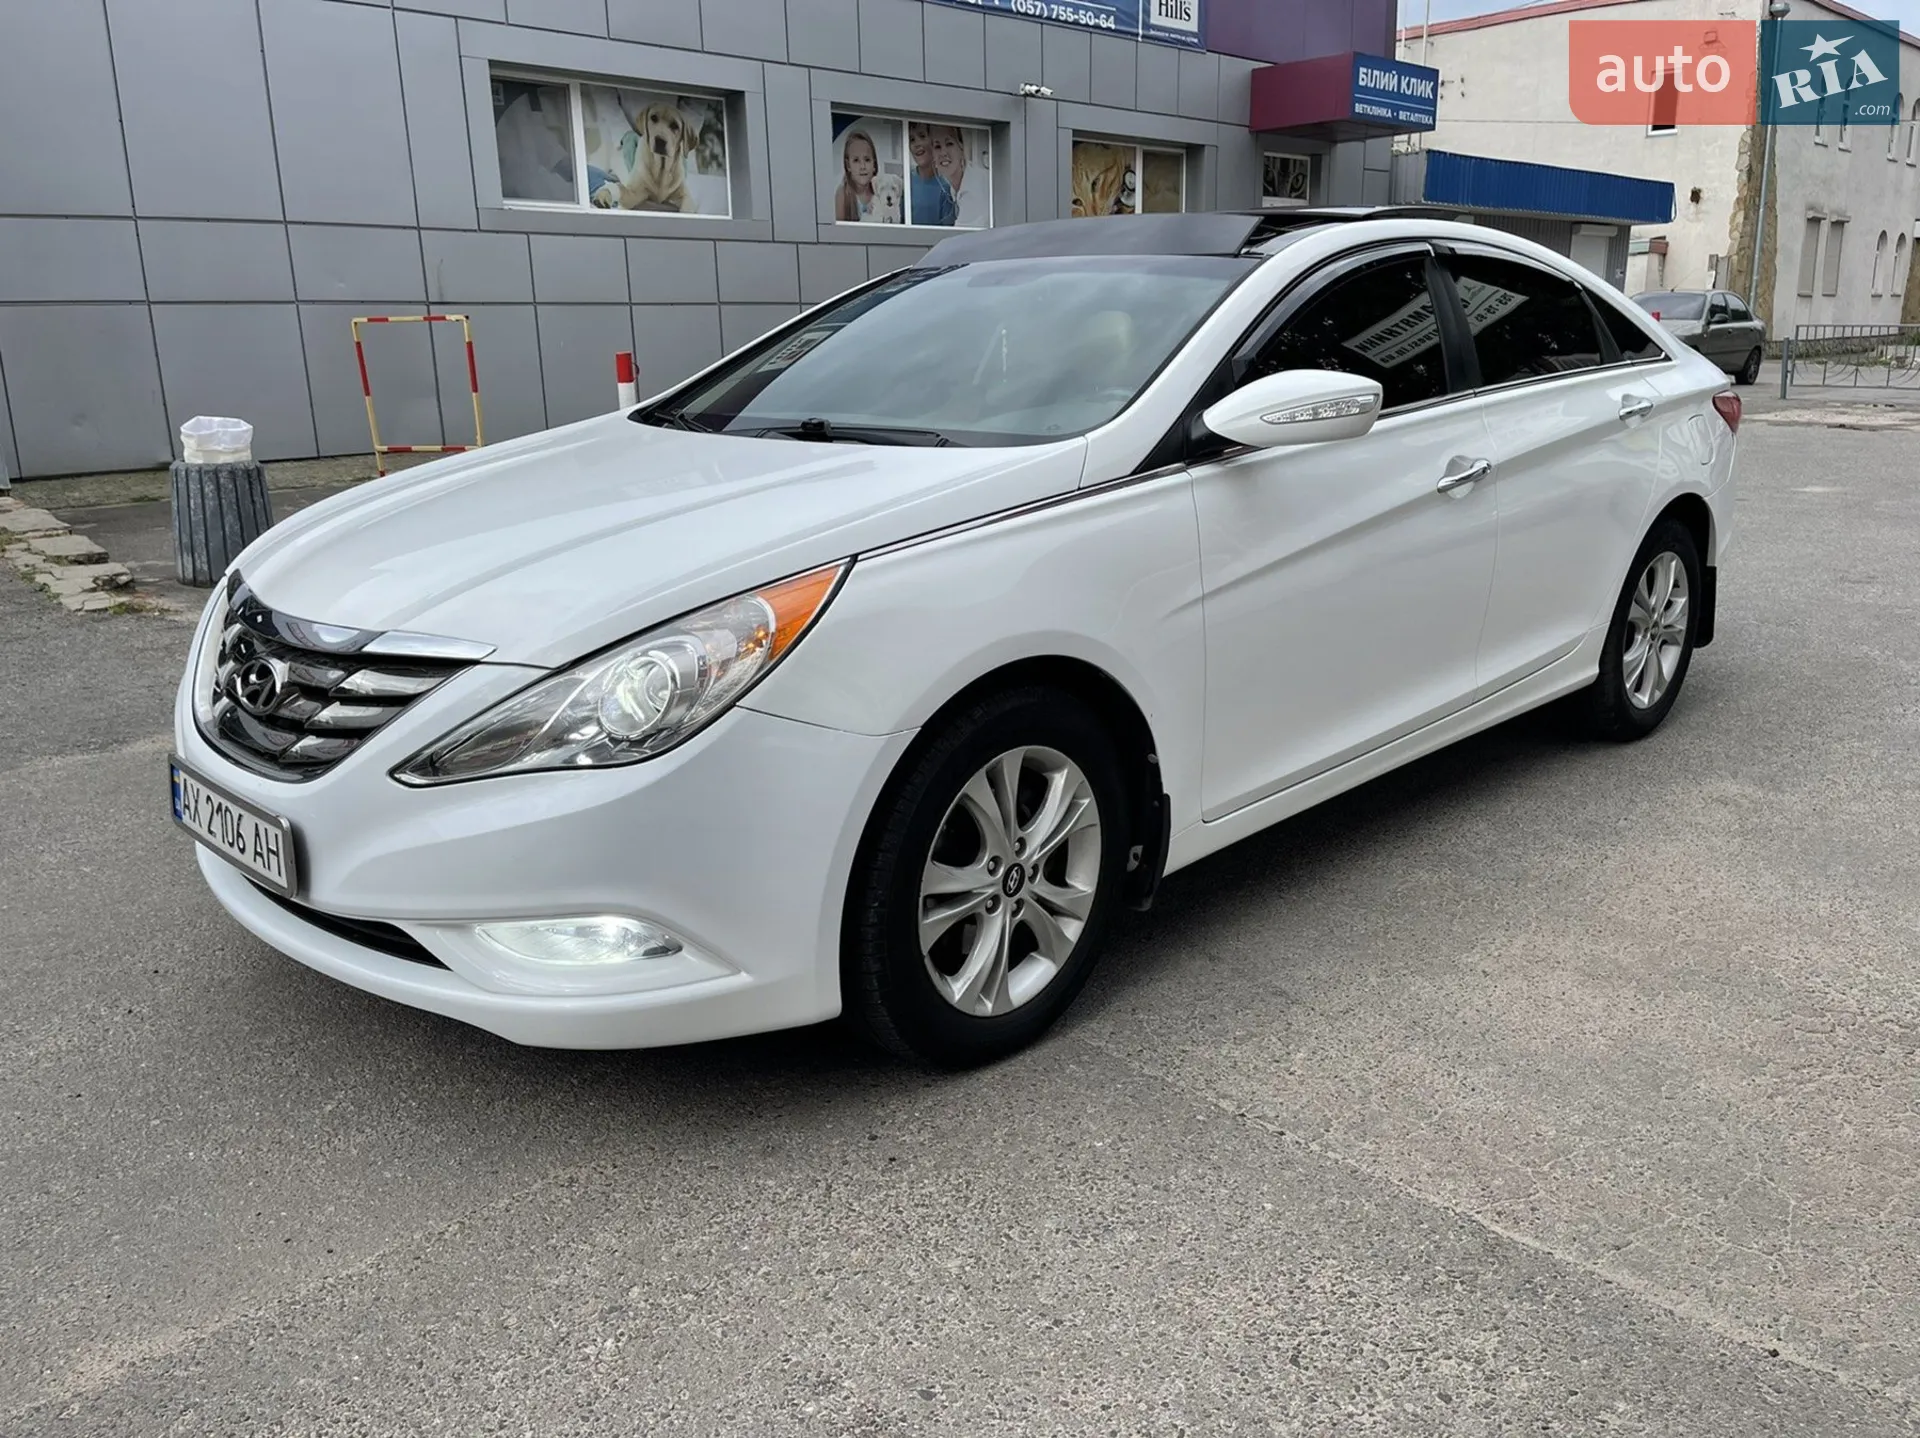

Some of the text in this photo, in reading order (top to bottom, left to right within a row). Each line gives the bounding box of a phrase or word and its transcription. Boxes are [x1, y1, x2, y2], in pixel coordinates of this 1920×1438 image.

[1011, 0, 1115, 29] (057) 755-50-64
[1158, 0, 1191, 21] Hill's
[1358, 66, 1434, 99] БІЛИЙ КЛИК
[183, 778, 282, 877] AX 2106 AH
